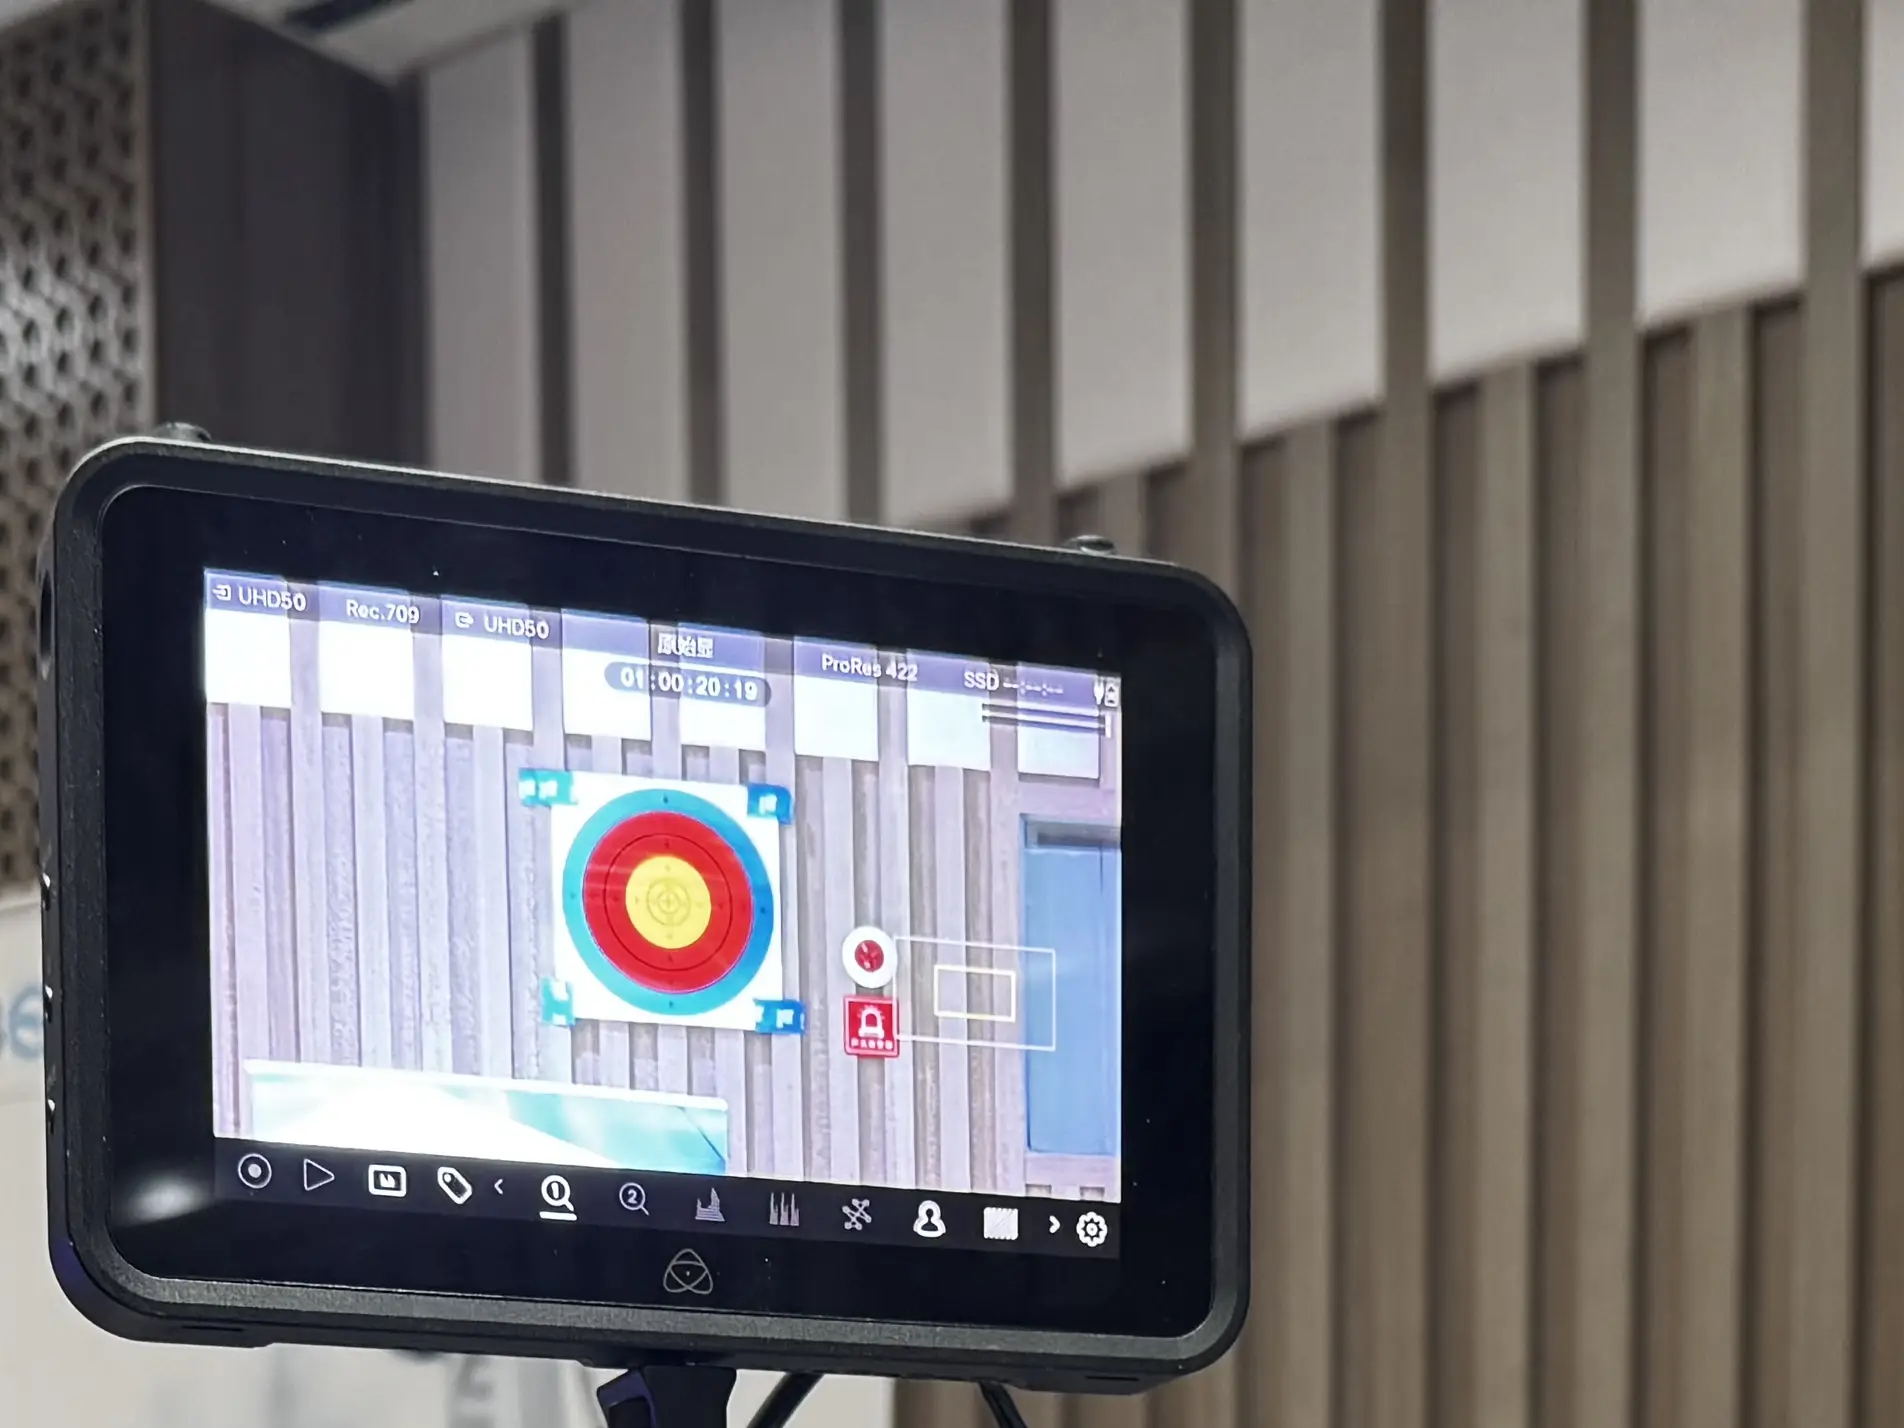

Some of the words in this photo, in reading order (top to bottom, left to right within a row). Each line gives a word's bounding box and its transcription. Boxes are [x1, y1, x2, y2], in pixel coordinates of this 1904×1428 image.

[238, 586, 307, 612] UHD50
[346, 599, 420, 625] Rec.709
[483, 615, 550, 640] UHD50
[620, 667, 759, 702] 01:00:20:19
[885, 662, 918, 683] 422
[964, 671, 1000, 692] SSD
